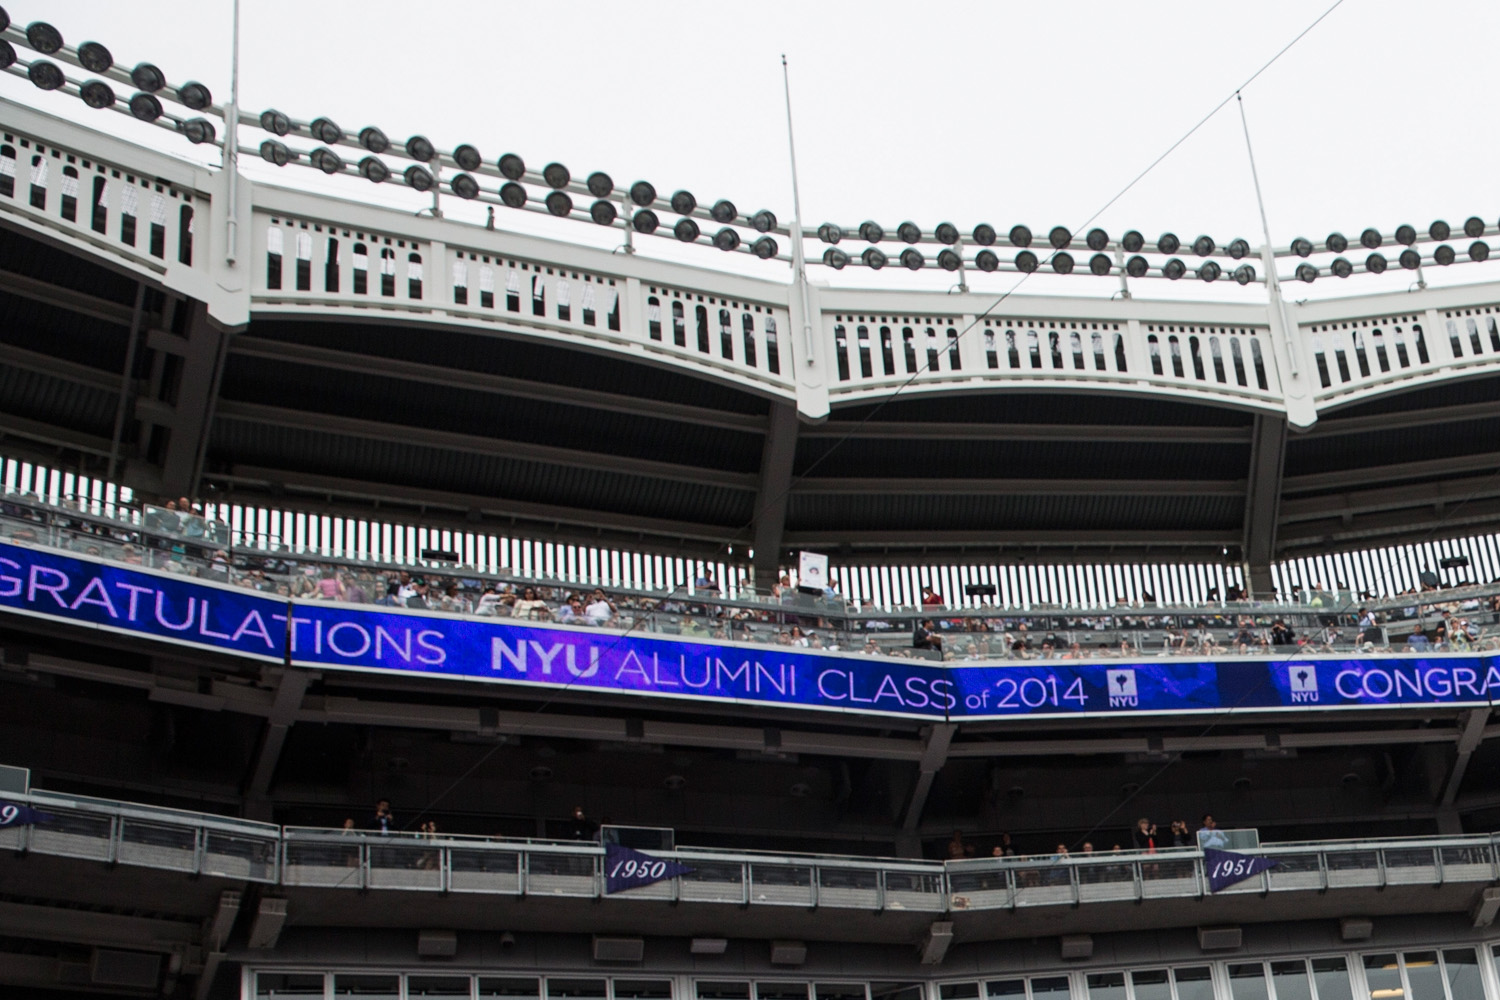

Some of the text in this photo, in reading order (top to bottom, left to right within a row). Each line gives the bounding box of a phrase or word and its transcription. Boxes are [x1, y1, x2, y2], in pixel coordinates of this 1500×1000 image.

[491, 637, 599, 677] NYU
[614, 650, 796, 697] ALUMNI
[816, 668, 957, 710] CLASS
[965, 689, 991, 709] of
[999, 676, 1089, 709] 2014
[1108, 695, 1139, 707] NYU
[1290, 689, 1320, 702] NYU
[611, 860, 666, 878] 1950
[1212, 858, 1255, 878] 1951
